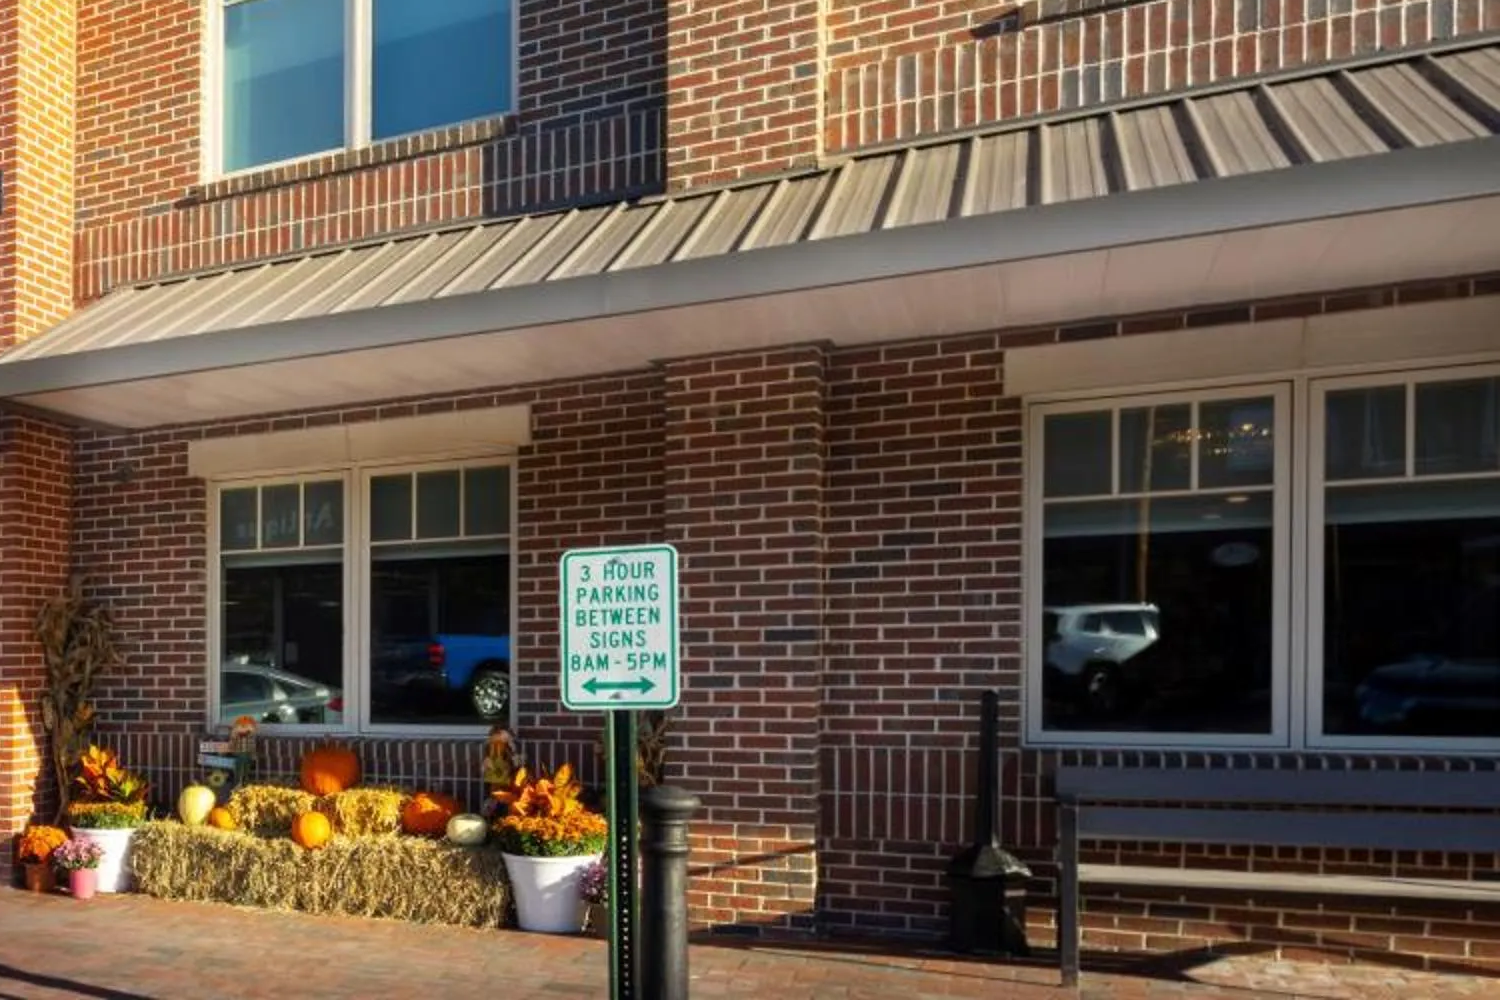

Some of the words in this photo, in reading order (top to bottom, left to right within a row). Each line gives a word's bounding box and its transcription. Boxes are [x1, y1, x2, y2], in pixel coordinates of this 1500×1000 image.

[580, 565, 592, 582] 3
[603, 561, 655, 581] HOUR
[576, 583, 660, 603] PARKING
[575, 607, 661, 627] BETWEEN
[589, 629, 647, 649] SIGNS
[571, 654, 609, 672] 8AM
[627, 652, 667, 671] 5PM
